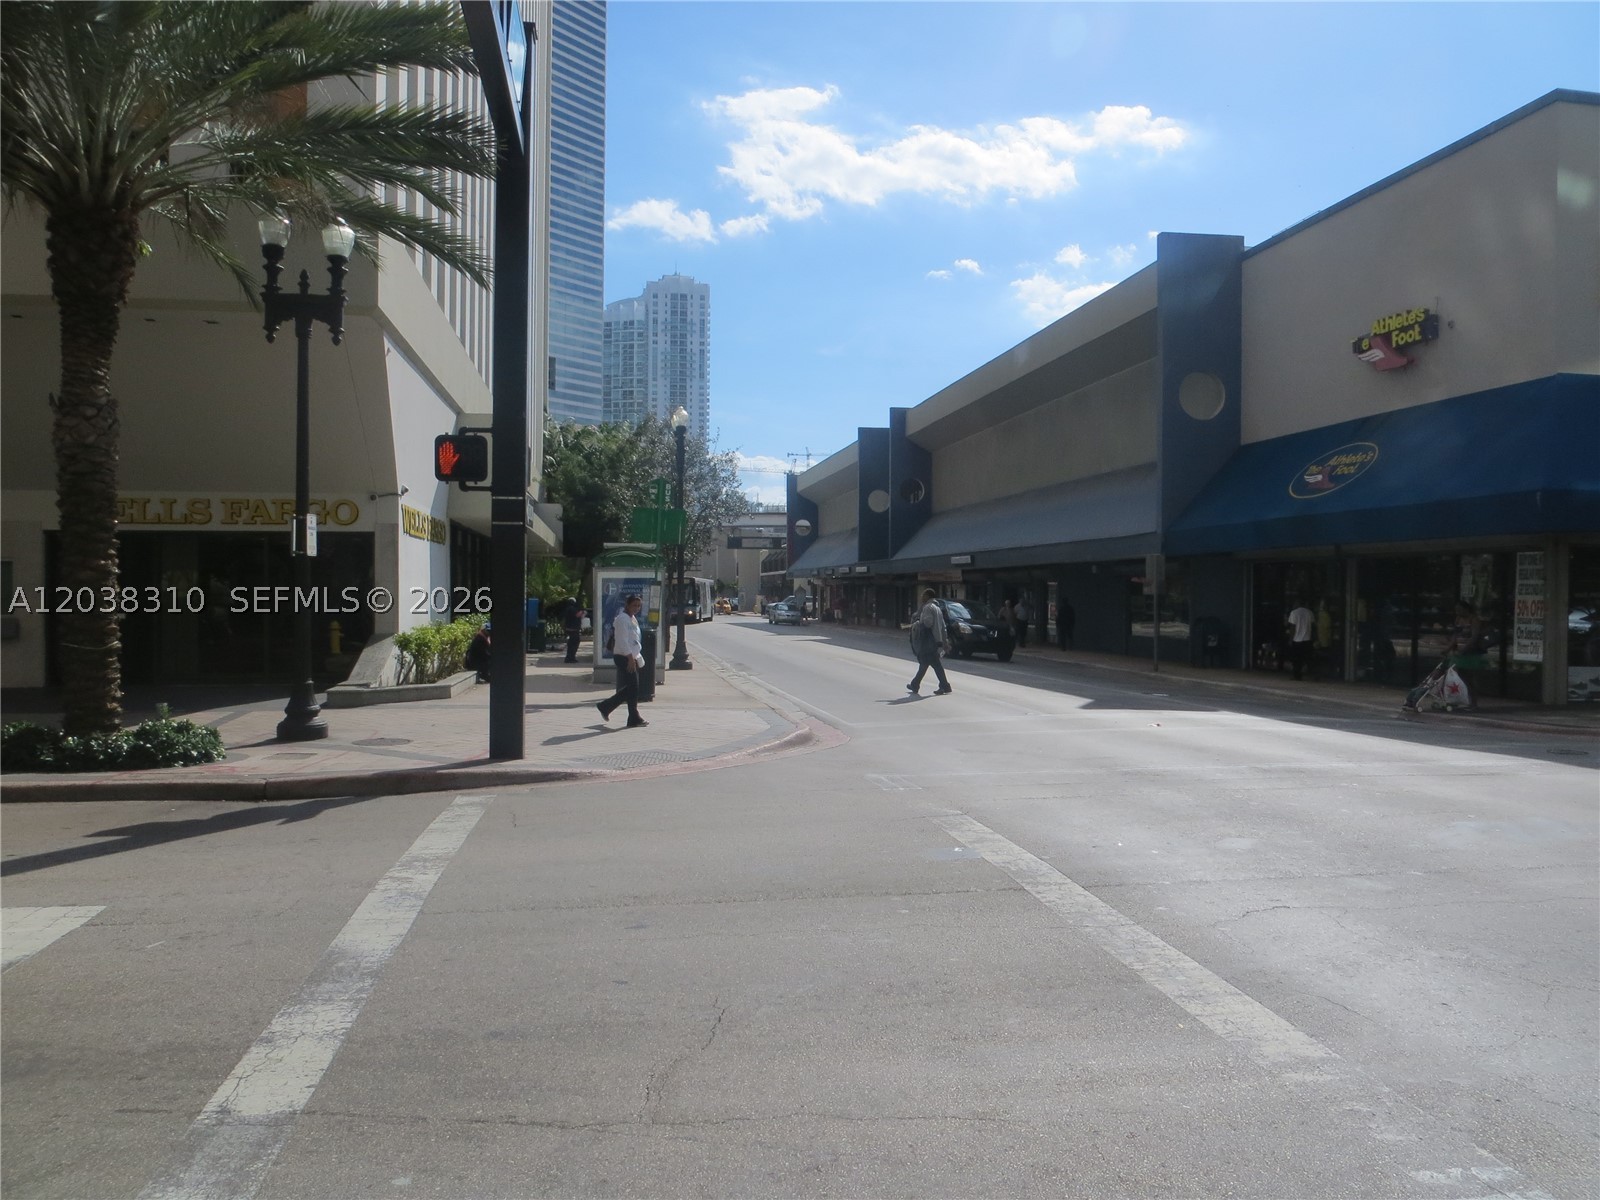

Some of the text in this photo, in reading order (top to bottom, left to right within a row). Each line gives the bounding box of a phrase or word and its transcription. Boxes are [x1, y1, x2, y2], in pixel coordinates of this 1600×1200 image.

[1371, 307, 1425, 336] Athlete's
[1391, 324, 1422, 348] Foot
[1324, 450, 1374, 467] Athlete's
[1332, 462, 1360, 476] Foot
[116, 497, 212, 525] ELLS
[401, 503, 446, 546] WELLS FARGO
